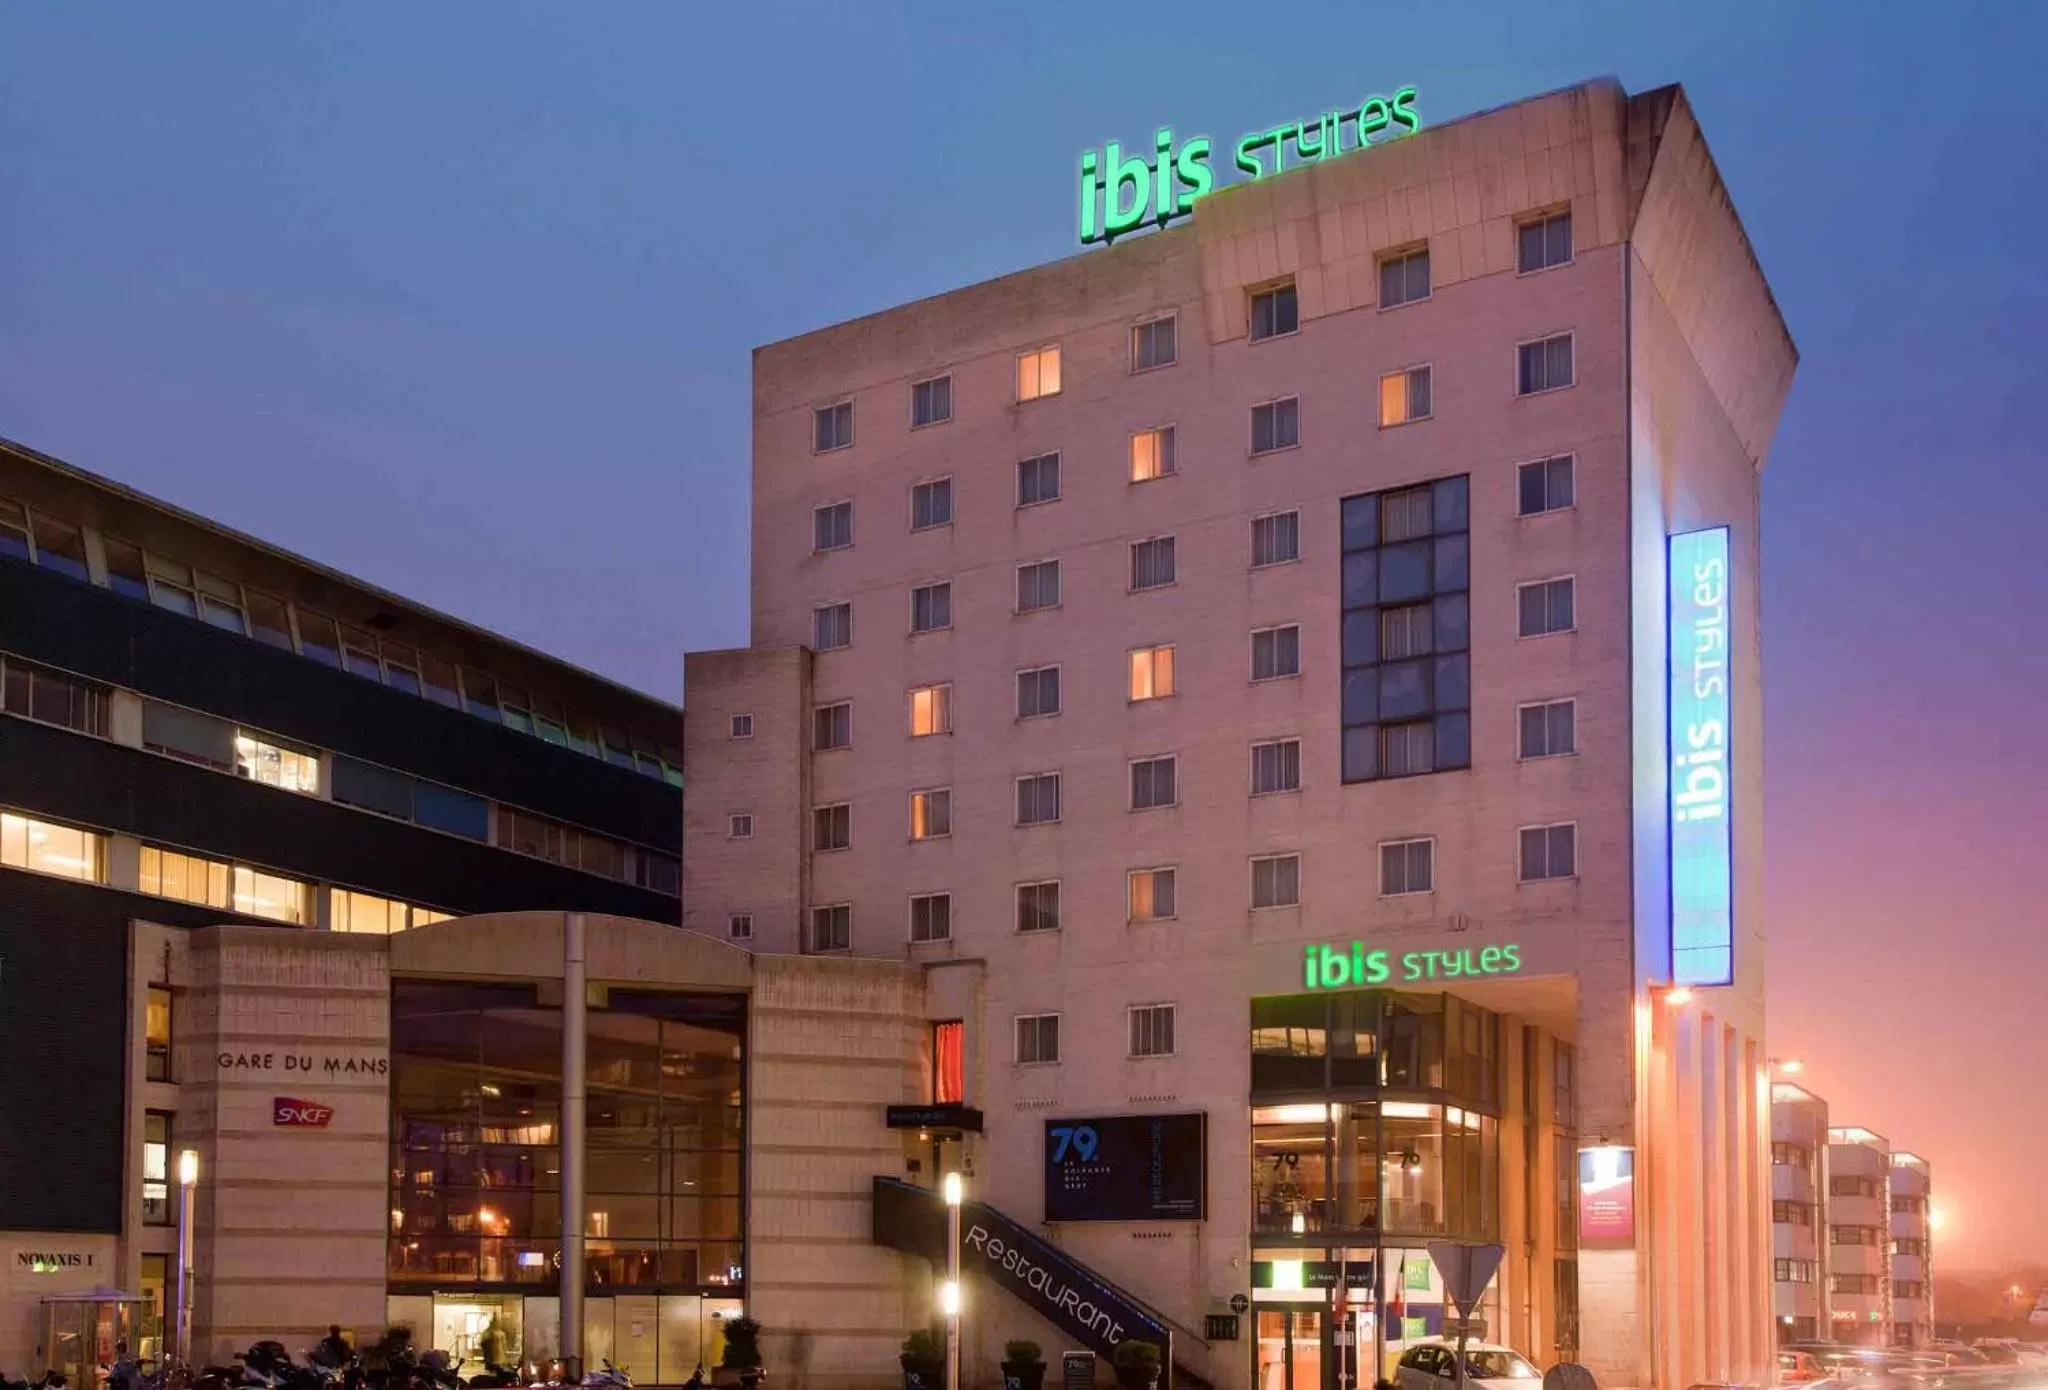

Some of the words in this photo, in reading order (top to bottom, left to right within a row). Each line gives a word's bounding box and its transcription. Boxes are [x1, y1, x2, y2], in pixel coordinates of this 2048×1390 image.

[1080, 128, 1213, 243] ibis
[1676, 719, 1724, 824] ibis
[1304, 940, 1391, 989] ibis
[218, 1052, 273, 1069] GARE
[284, 1055, 313, 1071] DU
[324, 1058, 388, 1075] MANS
[275, 1106, 330, 1123] SNCF
[18, 1253, 81, 1267] NOVAXIS
